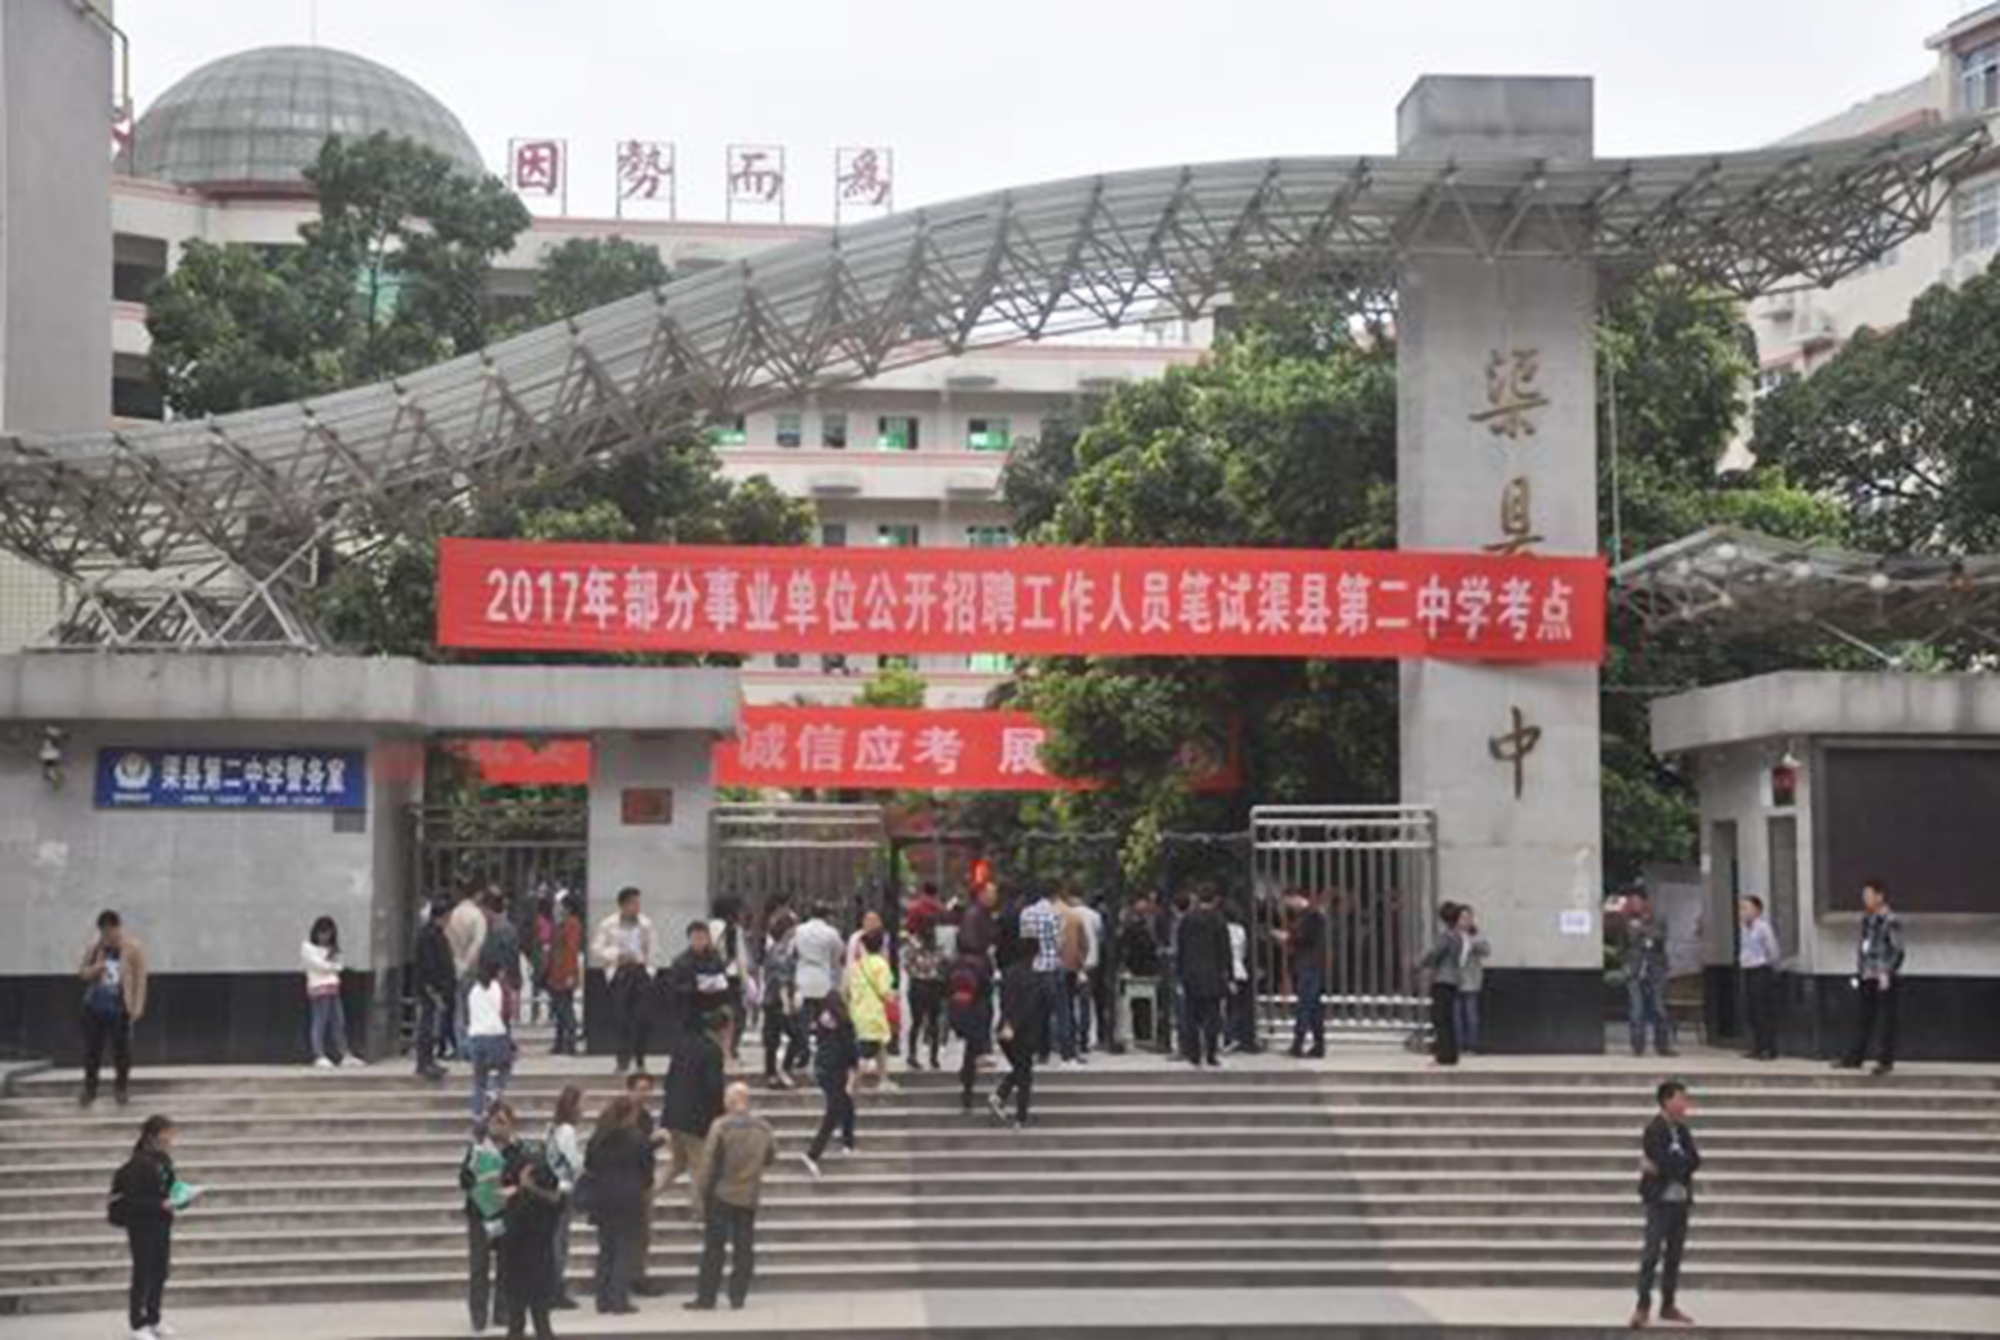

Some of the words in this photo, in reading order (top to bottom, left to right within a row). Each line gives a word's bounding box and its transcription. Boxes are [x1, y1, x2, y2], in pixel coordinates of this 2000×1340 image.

[486, 565, 1573, 643] 2017年部分事业单位公开招聘工作人员笔试渠县第二中学考点
[160, 754, 346, 793] 渠县第二中学警务室
[738, 723, 965, 775] 诚信应考
